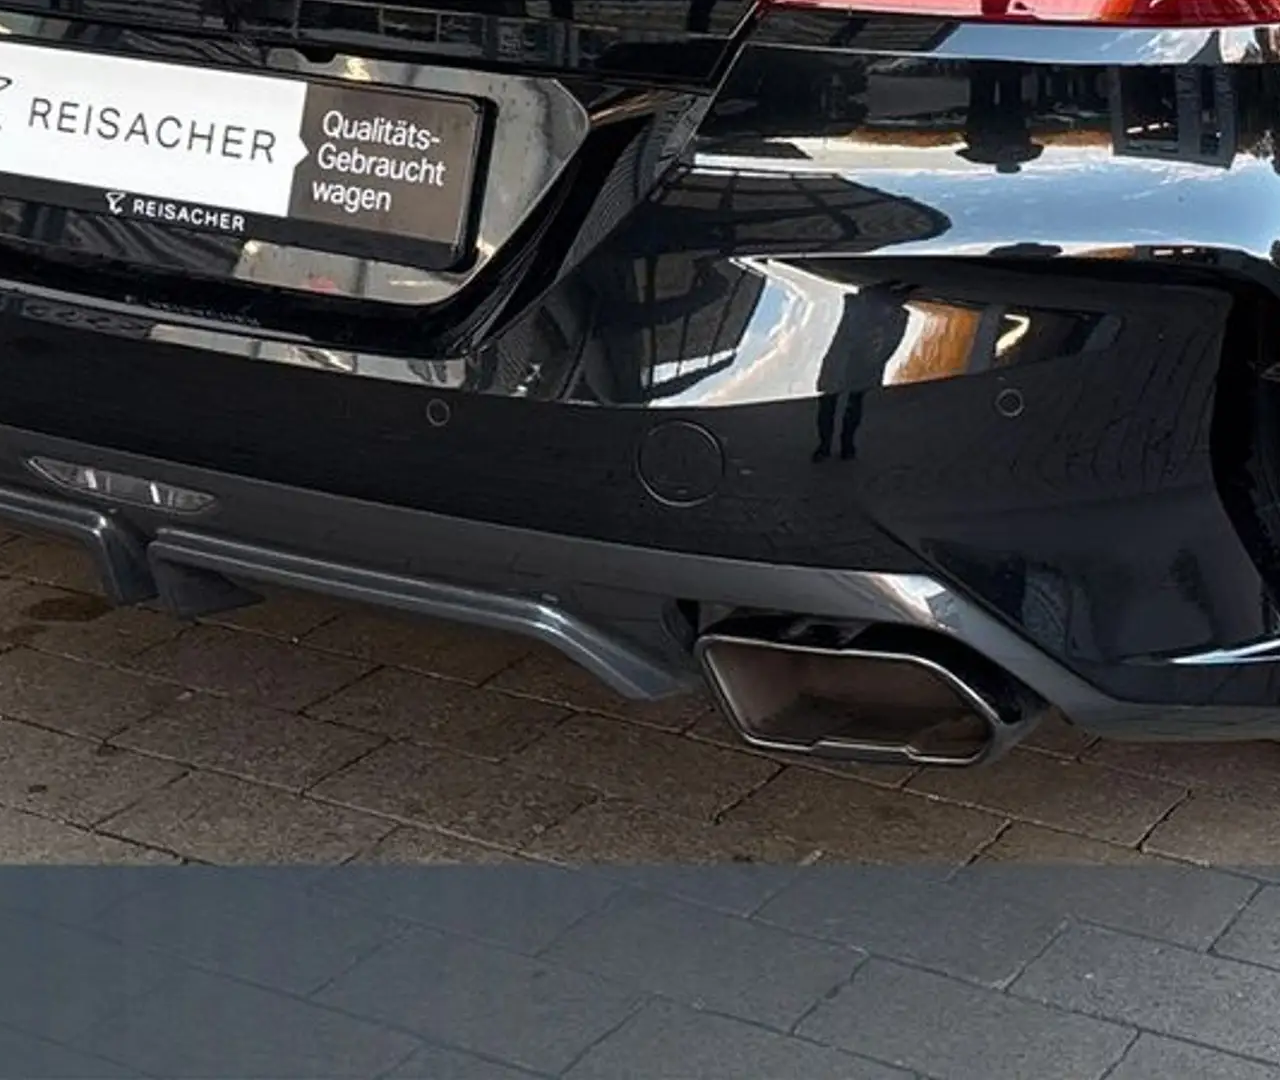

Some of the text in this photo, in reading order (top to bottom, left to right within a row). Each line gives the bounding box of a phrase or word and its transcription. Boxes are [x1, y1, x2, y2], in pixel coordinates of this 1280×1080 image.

[28, 97, 276, 163] REISACHER
[322, 110, 442, 150] Qualitäts-
[317, 142, 447, 187] Gebraucht
[133, 199, 246, 232] REISACHER
[312, 180, 392, 213] wagen
